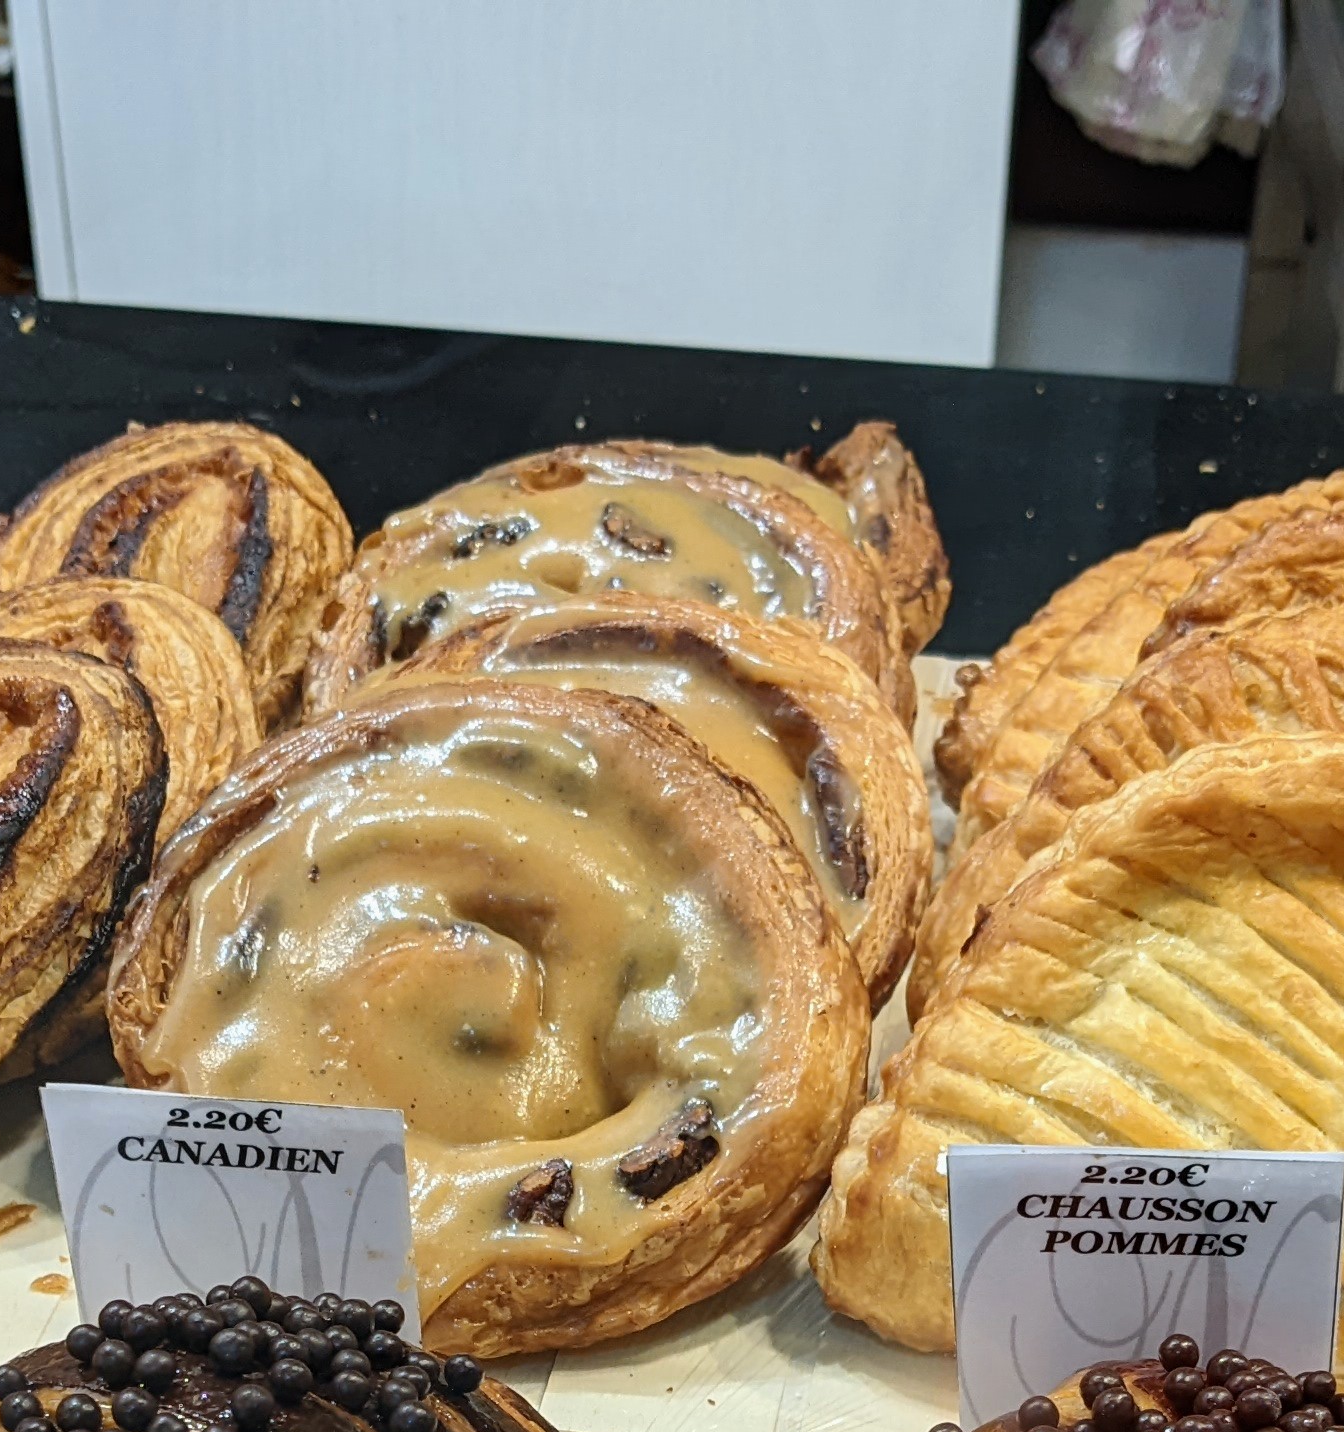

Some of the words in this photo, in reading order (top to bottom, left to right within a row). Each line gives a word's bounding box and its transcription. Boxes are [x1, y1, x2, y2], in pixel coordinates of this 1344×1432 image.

[166, 1107, 283, 1134] 2.20€
[117, 1136, 345, 1175] CANADIEN
[1080, 1163, 1210, 1188] 2.20€
[1016, 1194, 1278, 1224] CHAUSSON
[1039, 1229, 1248, 1258] POMMES
